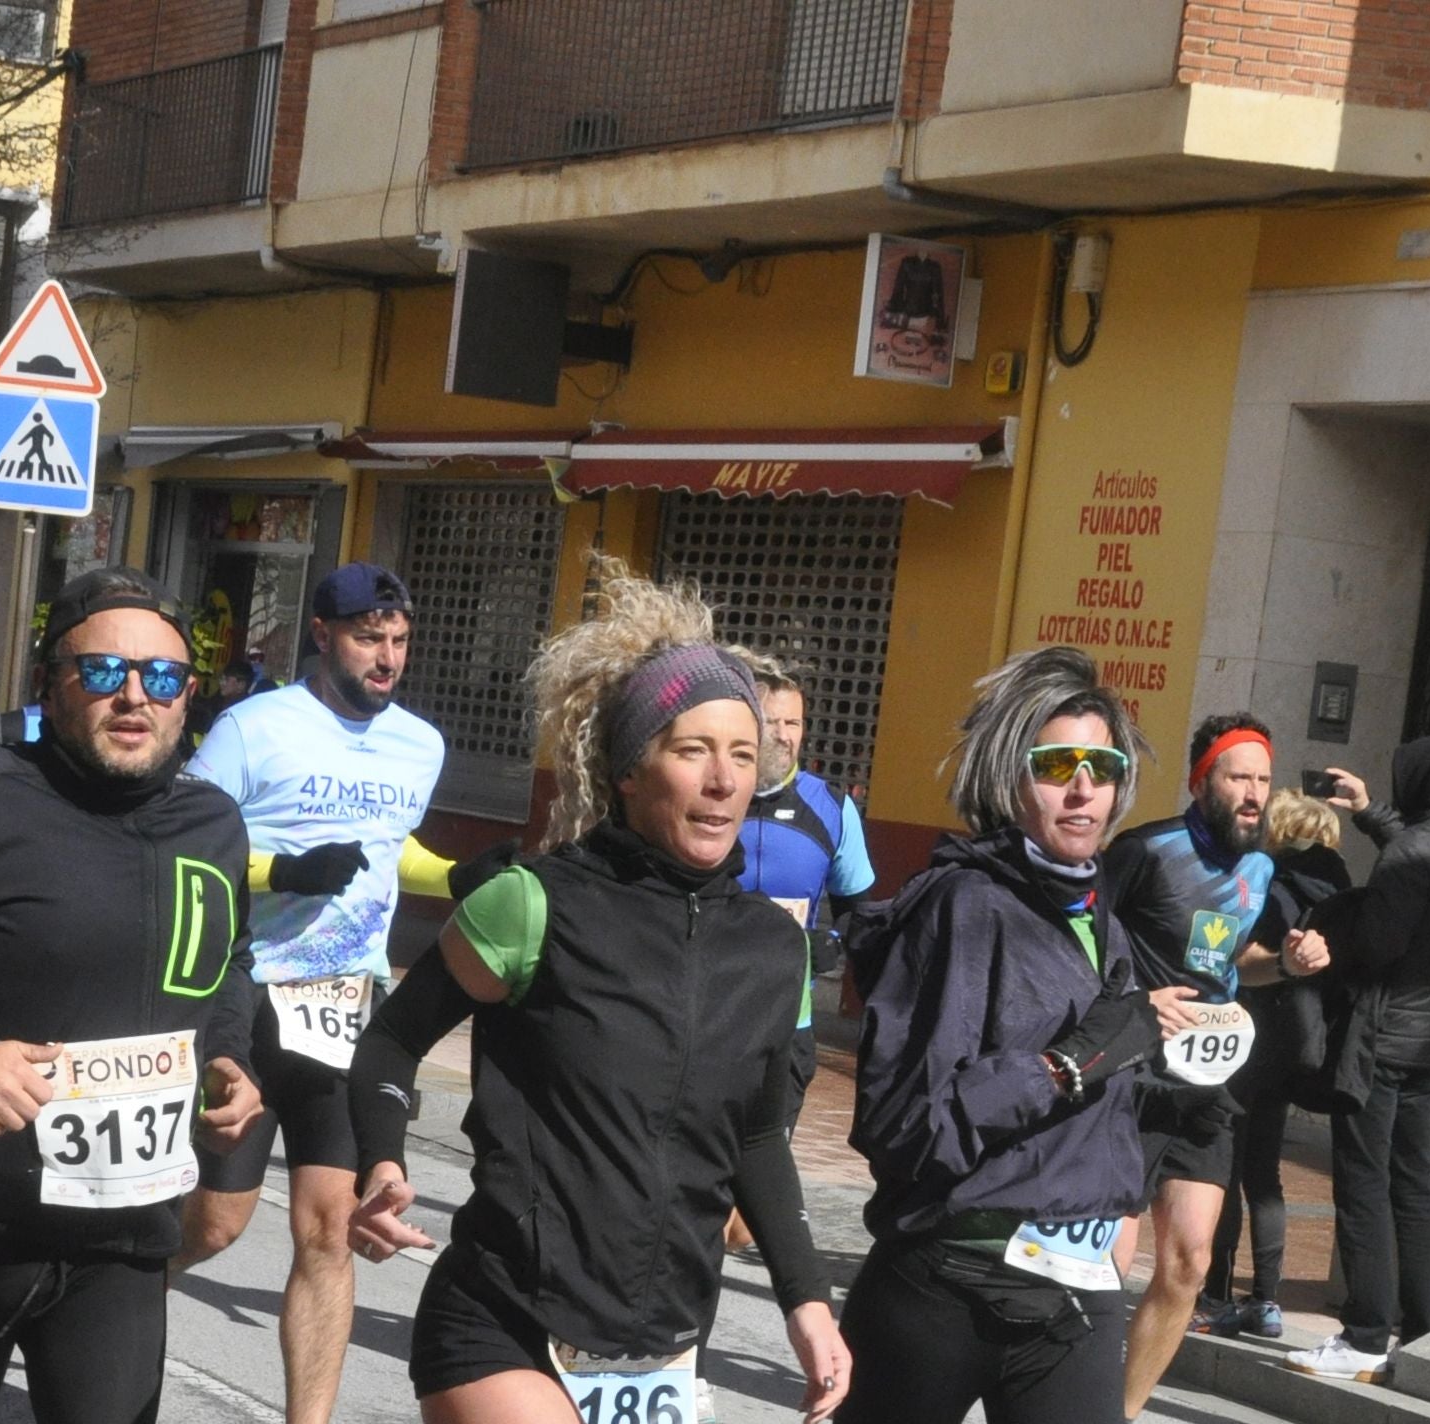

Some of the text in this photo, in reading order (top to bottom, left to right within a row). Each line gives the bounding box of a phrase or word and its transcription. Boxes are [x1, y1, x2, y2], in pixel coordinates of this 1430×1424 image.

[712, 462, 800, 489] MAYTE
[1092, 469, 1158, 499] Artículos
[1079, 505, 1162, 536] FUMADOR
[1097, 543, 1133, 573] PIEL
[1077, 578, 1144, 610] REGALO
[1101, 655, 1167, 691] MÓVILES
[299, 775, 333, 799] 47
[297, 800, 383, 821] MARATÓN
[294, 1004, 363, 1045] 165
[1198, 1010, 1241, 1024] ONDO
[1180, 1034, 1240, 1063] 199
[72, 1051, 173, 1084] FONDO
[50, 1100, 186, 1166] 3137
